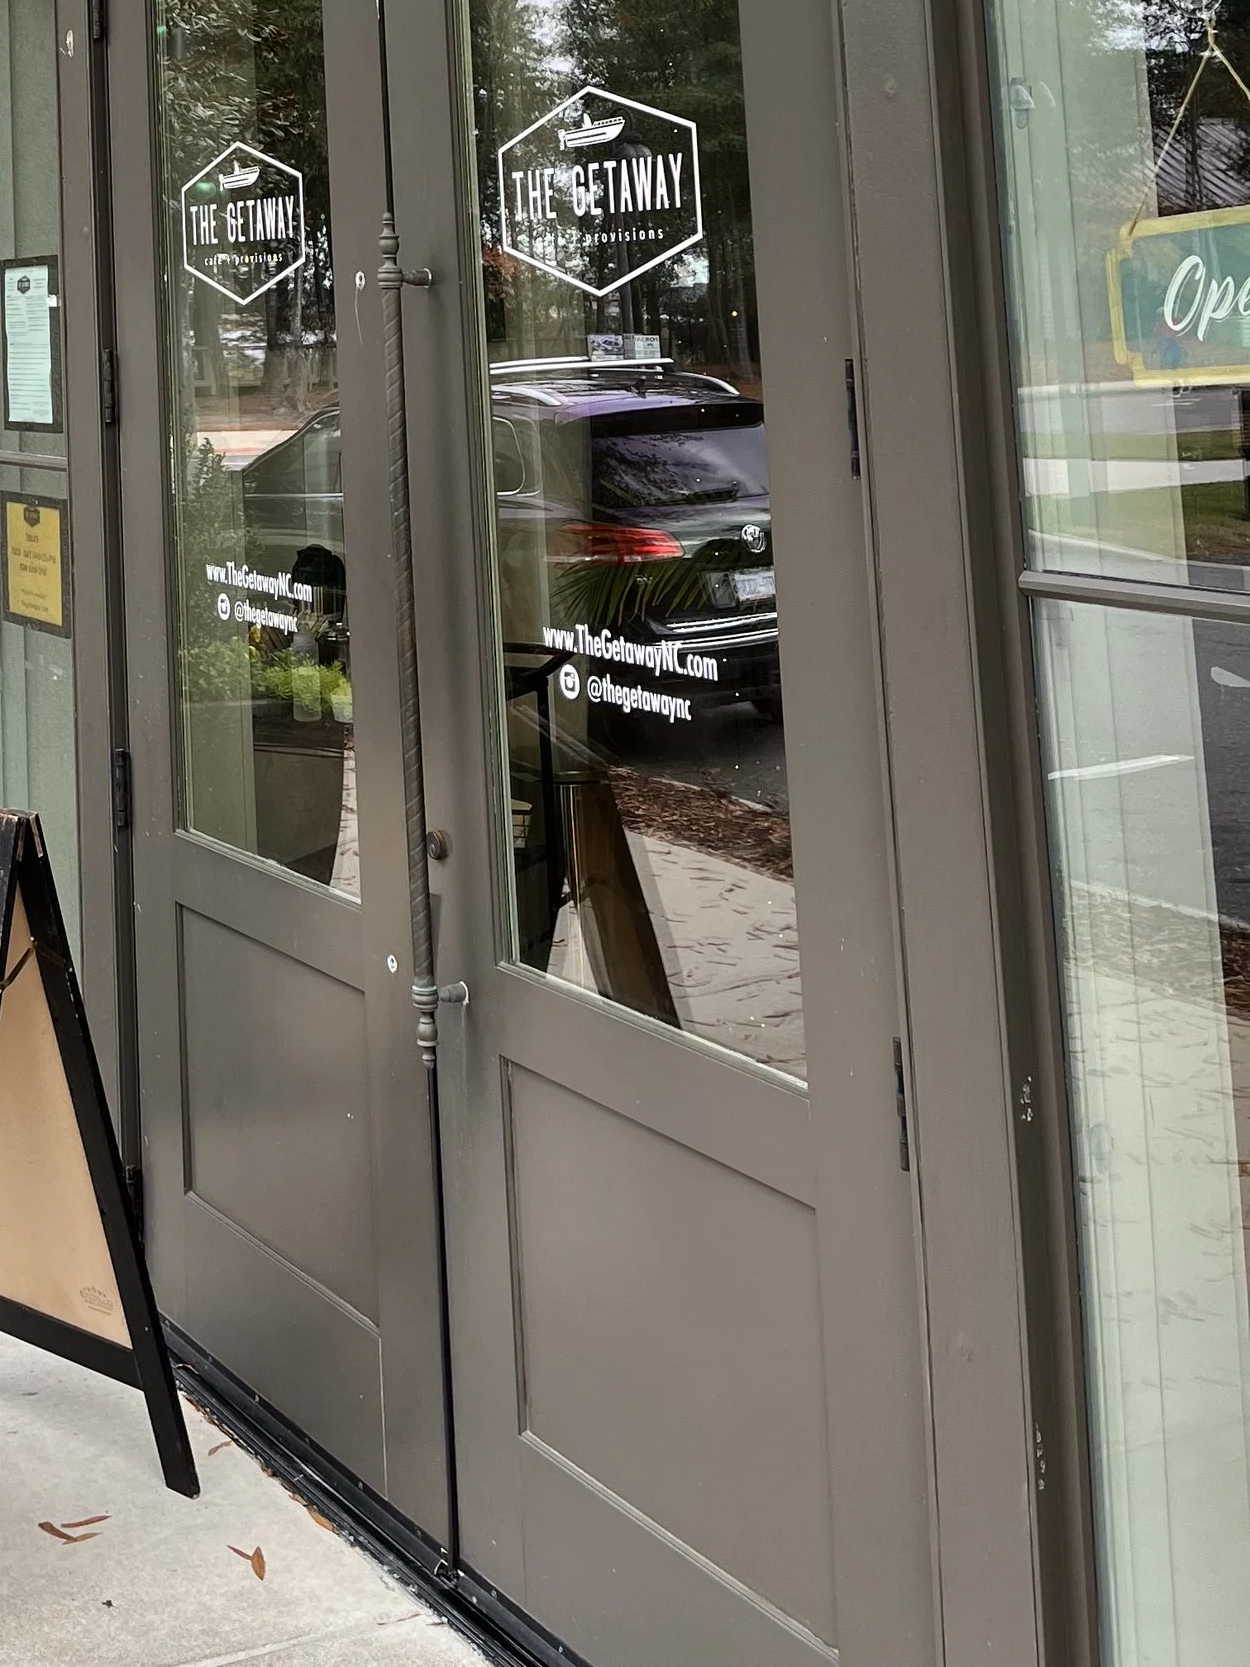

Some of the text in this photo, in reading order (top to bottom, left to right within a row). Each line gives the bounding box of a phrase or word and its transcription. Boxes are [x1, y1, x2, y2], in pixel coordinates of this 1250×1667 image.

[512, 152, 683, 221] THE GETAWAY
[190, 195, 294, 245] THE GETAWAY
[585, 226, 664, 243] provisions
[235, 251, 283, 266] provisions
[206, 561, 313, 602] www.TheGetawayNC.com
[234, 598, 298, 635] @thegetawaync
[543, 624, 718, 681] www.TheGetawayNC.com
[587, 673, 692, 723] @thegetawaync
